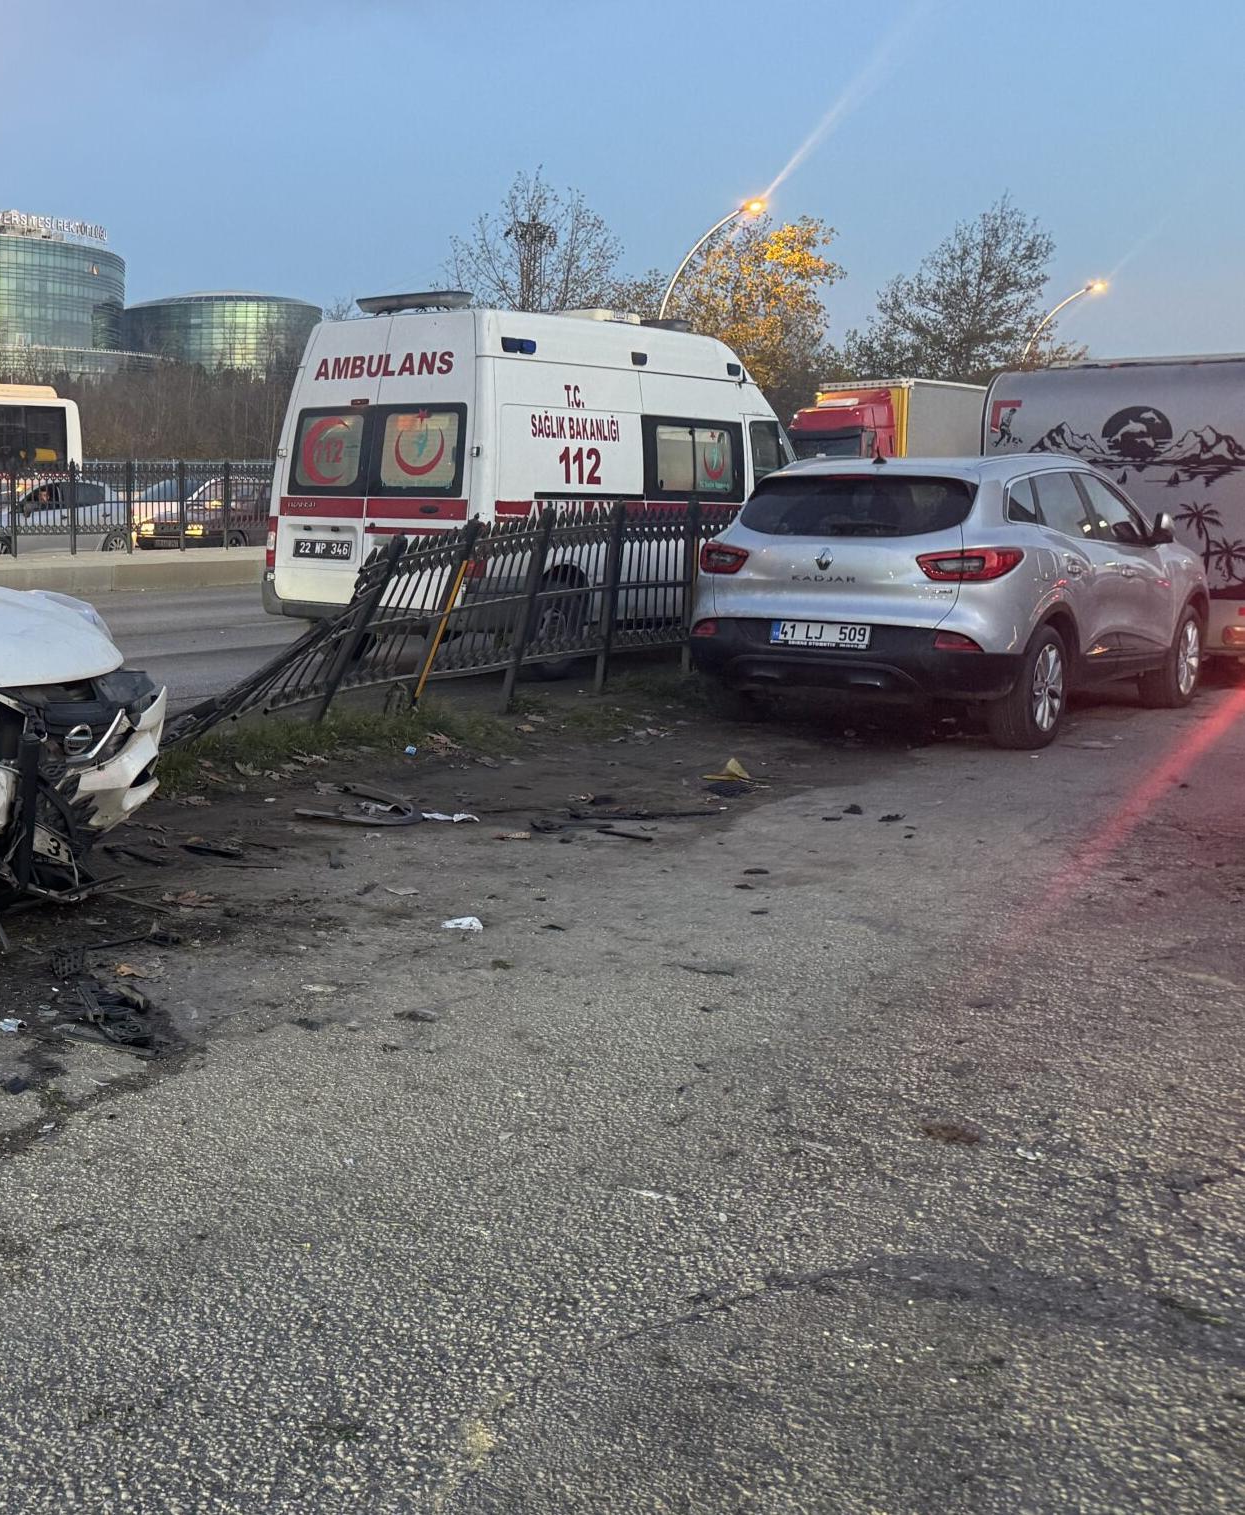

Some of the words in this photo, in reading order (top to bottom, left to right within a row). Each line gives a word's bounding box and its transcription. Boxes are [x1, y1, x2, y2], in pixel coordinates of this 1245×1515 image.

[314, 351, 454, 381] AMBULANS
[564, 385, 585, 408] T.C.
[531, 411, 566, 439] SAĞLIK
[568, 415, 620, 442] BAKANLIĞI
[315, 438, 344, 464] 112
[559, 446, 601, 485] 112
[299, 542, 311, 553] 22
[330, 543, 349, 555] 346
[791, 575, 856, 584] KADJAR
[780, 623, 796, 638] 41
[805, 624, 824, 640] LJ
[838, 626, 867, 642] 509
